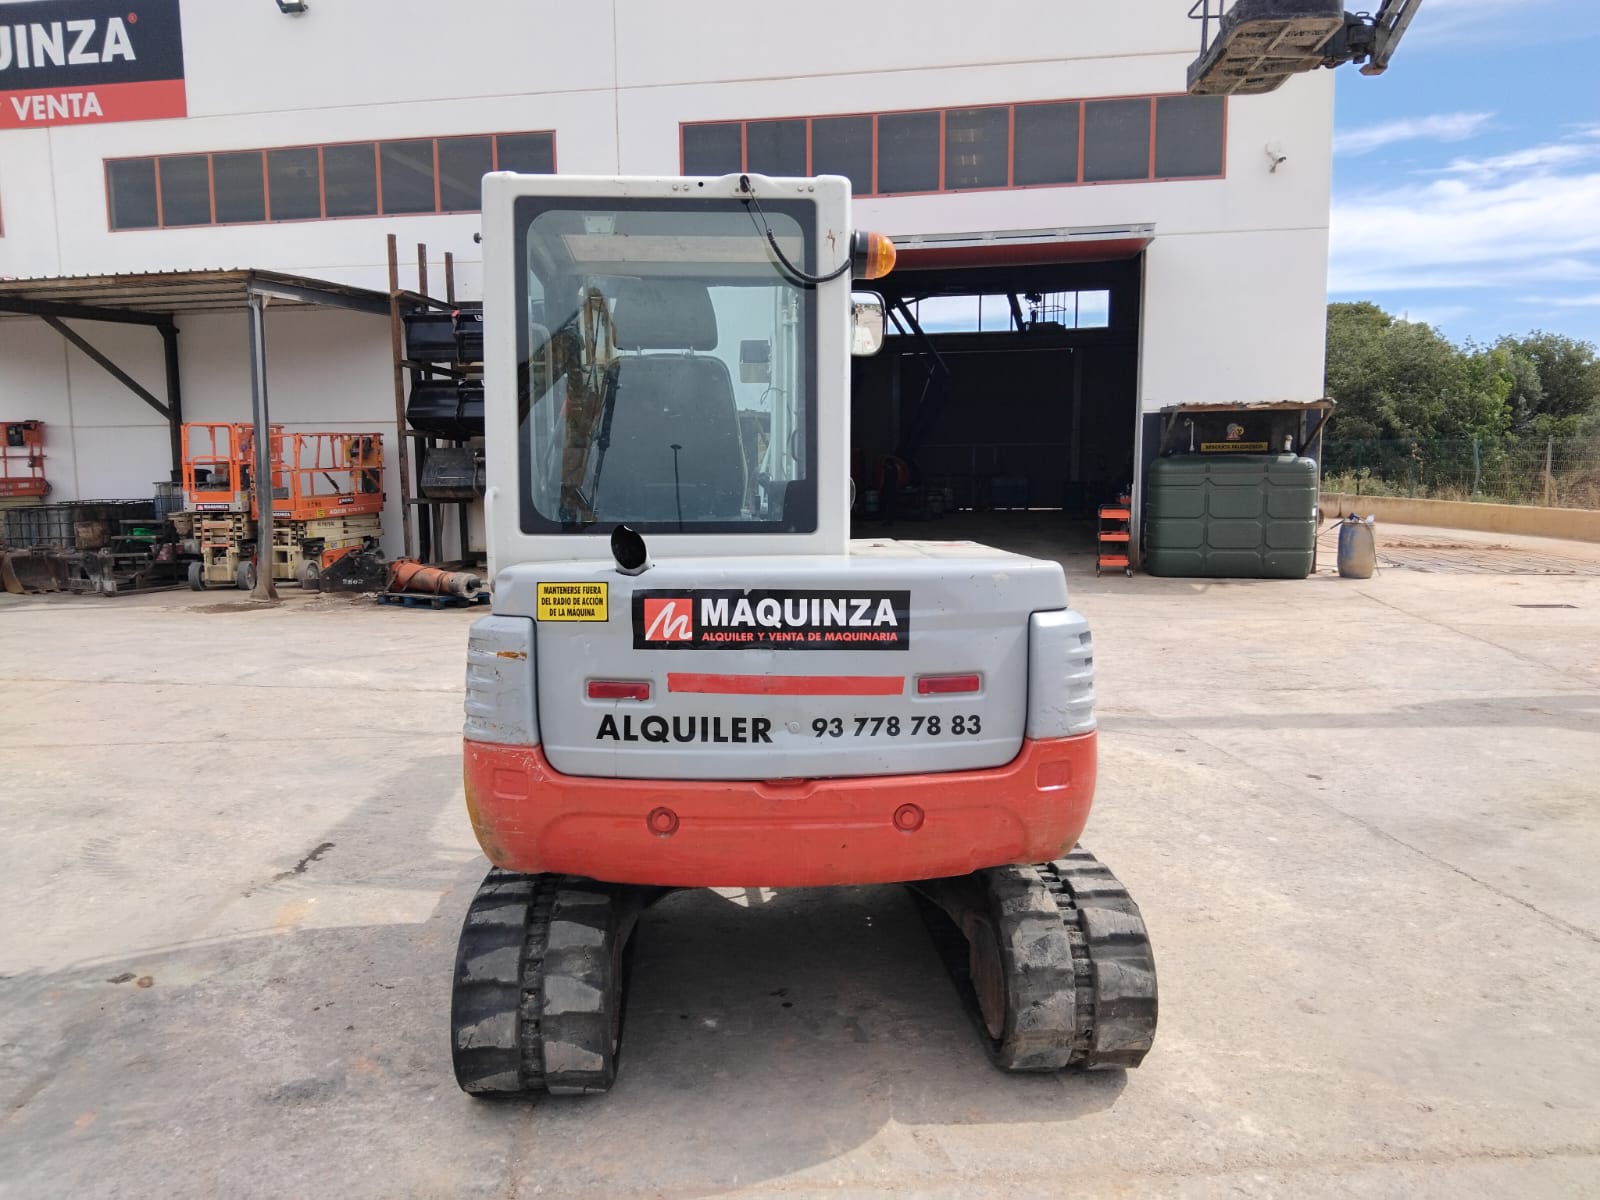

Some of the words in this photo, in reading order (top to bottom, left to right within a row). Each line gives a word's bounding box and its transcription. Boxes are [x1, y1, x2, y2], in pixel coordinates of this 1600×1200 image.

[10, 92, 103, 121] VENTA
[582, 586, 601, 594] FUERA
[541, 597, 551, 605] DEL
[553, 597, 571, 605] RADIO
[573, 597, 580, 605] DE
[701, 598, 898, 628] MAQUINZA
[701, 632, 752, 642] ALQUILER
[757, 632, 765, 641] Y
[769, 632, 804, 641] VENTA
[808, 632, 821, 641] DE
[825, 632, 898, 642] MAQUINARIA
[596, 714, 773, 744] ALQUILER
[811, 718, 844, 738] 93
[853, 717, 900, 737] 778
[911, 716, 942, 736] 78
[951, 715, 982, 736] 83
